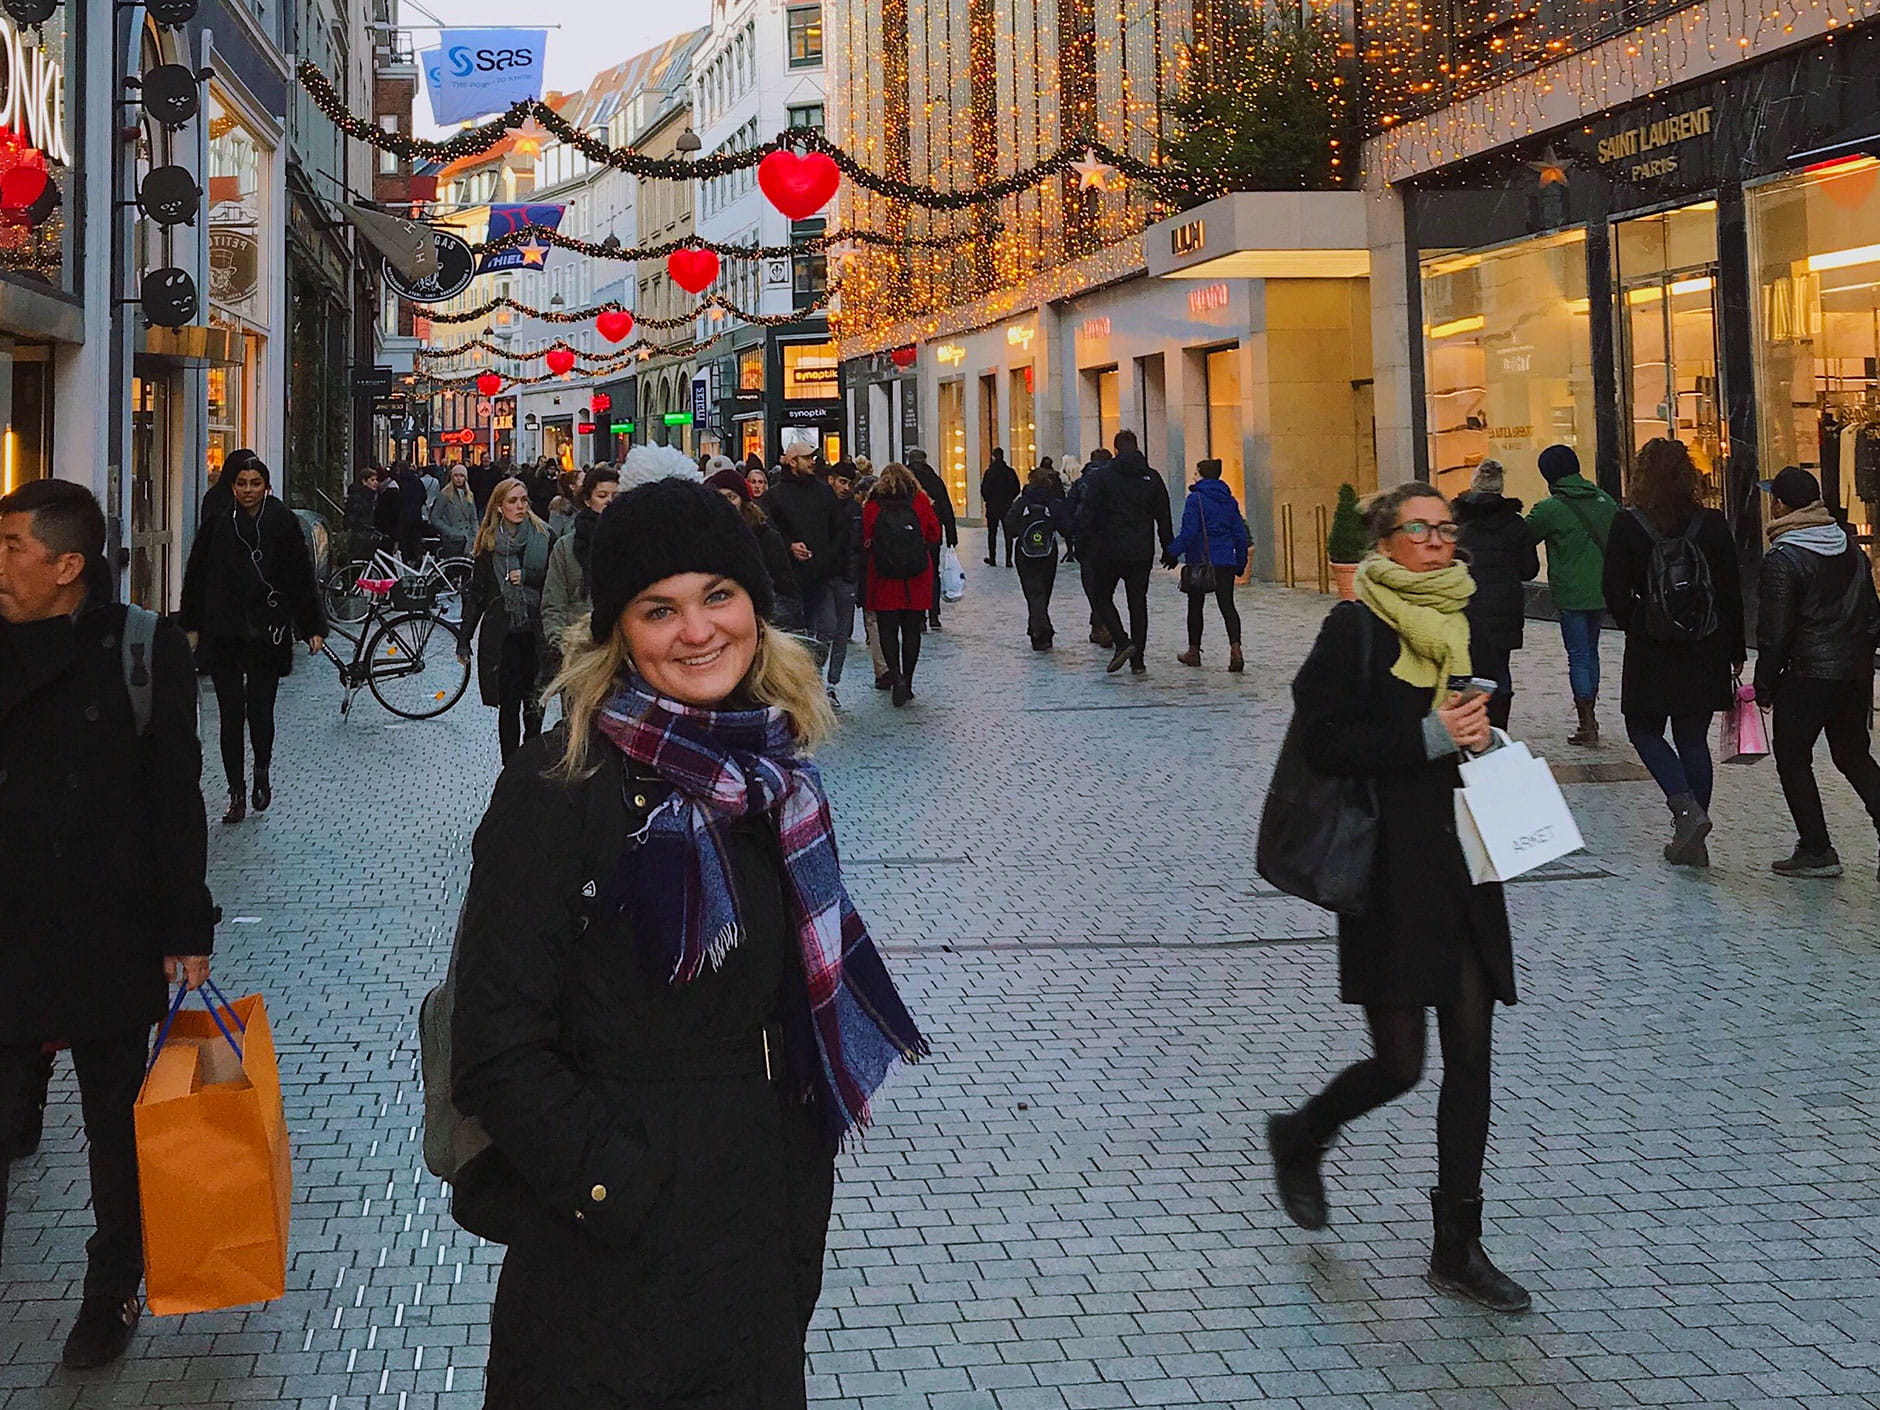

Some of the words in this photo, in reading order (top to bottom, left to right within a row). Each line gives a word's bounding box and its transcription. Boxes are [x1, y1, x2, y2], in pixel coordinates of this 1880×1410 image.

[1598, 129, 1639, 164] SAINT
[1640, 106, 1714, 152] LAURENT
[1632, 155, 1678, 182] PARIS
[488, 254, 523, 268] THIEL
[795, 369, 839, 381] synoptik
[696, 386, 706, 421] matas
[788, 408, 827, 418] synoptik
